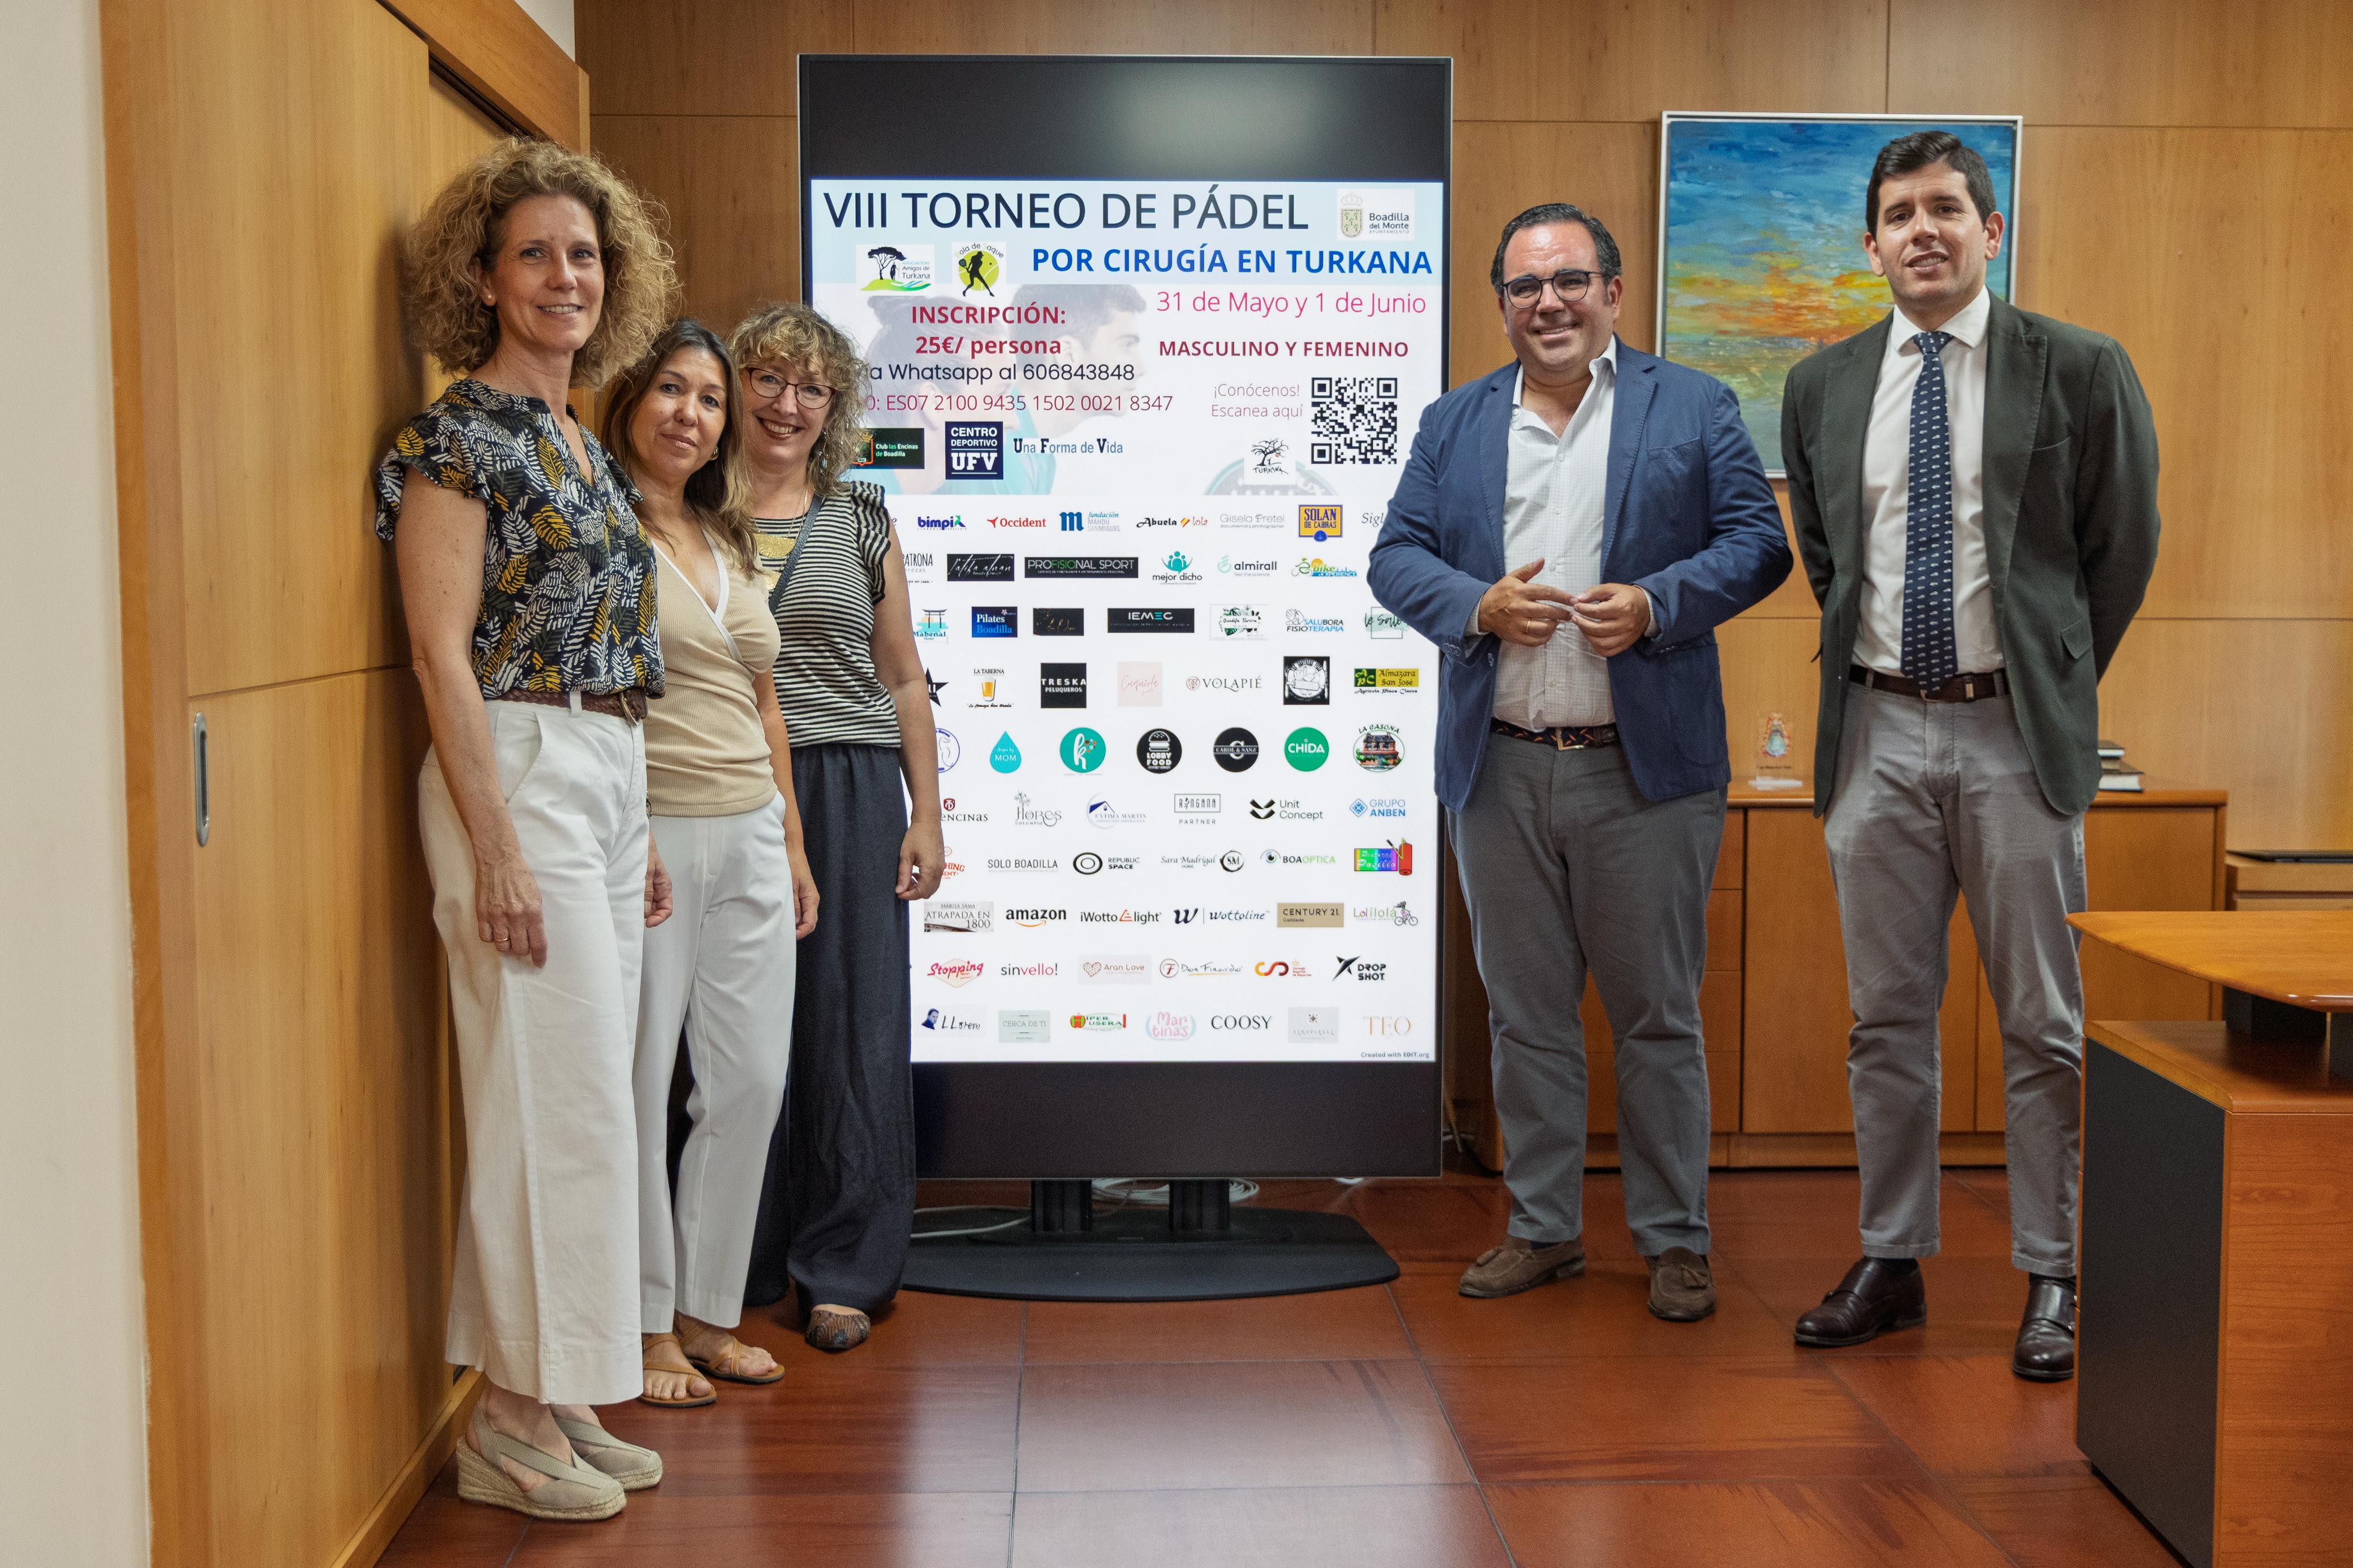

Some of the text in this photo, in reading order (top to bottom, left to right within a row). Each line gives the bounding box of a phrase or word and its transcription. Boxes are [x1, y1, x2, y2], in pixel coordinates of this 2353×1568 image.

[824, 184, 1309, 229] VIII TORNEO DE PÁDEL
[1369, 213, 1410, 222] Boadilla
[955, 246, 970, 258] Bola
[982, 244, 1004, 258] Saque
[1033, 243, 1432, 274] POR CIRUGÍA EN TURKANA
[1157, 291, 1426, 318] 31 de Mayo y 1 de Junio
[912, 302, 1066, 324] INSCRIPCIÓN:
[915, 336, 1061, 358] 25€/ persona
[1160, 341, 1408, 357] MASCULINO Y FEMENINO
[889, 363, 1135, 385] Whatsapp al 606843848
[1214, 384, 1300, 399] ¡Conócenos!
[887, 395, 1173, 411] ES07 2100 9435 1502 0021 8347
[1212, 404, 1303, 420] Escanea aquí
[951, 427, 997, 437] CENTRO
[1014, 438, 1123, 453] Una Forma de Vida
[951, 453, 997, 470] UFV
[999, 518, 1046, 528] Occident
[1136, 517, 1177, 528] Abuela
[1220, 514, 1285, 523] Gisela Pretel
[1028, 560, 1135, 569] PROFISIONAL SPORT
[1234, 561, 1277, 571] almirall
[1152, 572, 1203, 582] mejor dicho
[976, 614, 1005, 623] Pilates
[1128, 612, 1174, 620] IEMEC
[976, 624, 1013, 634] Boadilla
[1378, 669, 1416, 678] Almazara
[1203, 676, 1262, 692] VOLAPIÉ
[1369, 723, 1399, 734] CASONA
[1279, 800, 1299, 809] Unit
[1279, 810, 1323, 821] Concept
[988, 859, 1058, 869] SOLO BOADILLA
[1181, 854, 1216, 867] Madrigal
[1006, 909, 1066, 920] amazon
[1080, 912, 1160, 924] iWotto light
[967, 919, 990, 928] 1800
[927, 960, 984, 978] Stopping
[1001, 963, 1058, 975] sinvello!
[1211, 1015, 1272, 1029] COOSY
